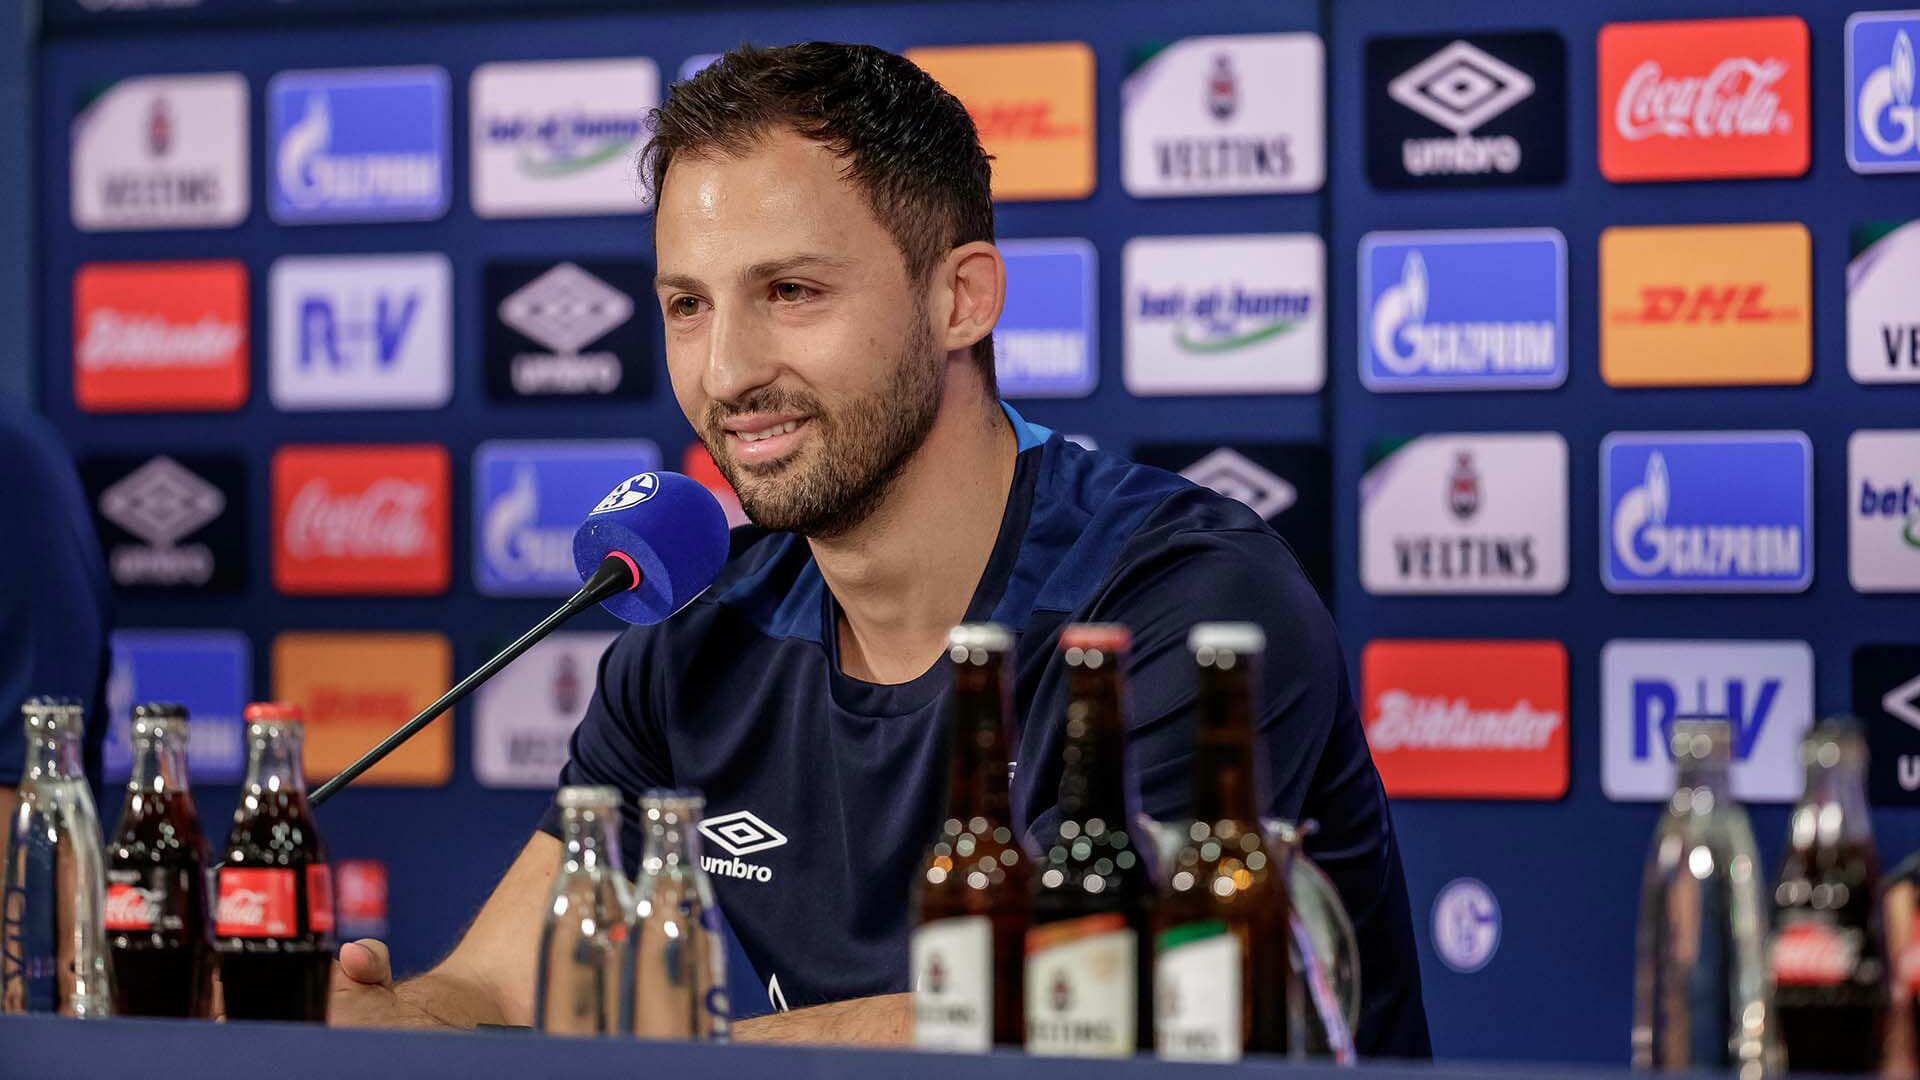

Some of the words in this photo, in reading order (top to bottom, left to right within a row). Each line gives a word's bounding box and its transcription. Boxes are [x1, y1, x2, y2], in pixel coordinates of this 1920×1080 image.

[1616, 58, 1792, 141] Coca-Cola
[1153, 135, 1294, 180] VELTINS
[1402, 136, 1521, 176] umbro
[1636, 283, 1773, 325] DHL
[1393, 534, 1537, 581] VELTINS
[1668, 525, 1800, 577] GAZPROM
[699, 855, 772, 883] umbro
